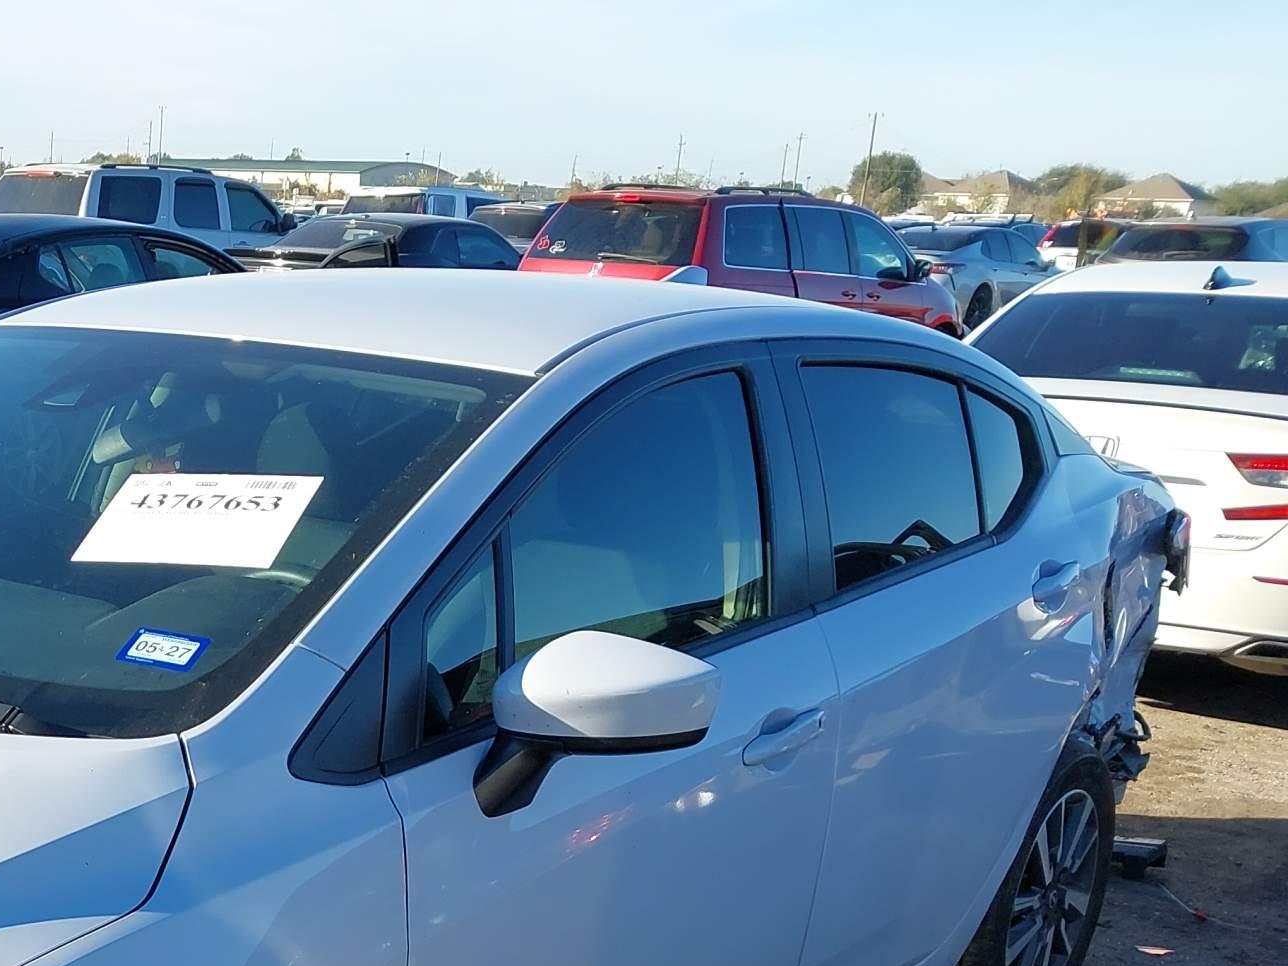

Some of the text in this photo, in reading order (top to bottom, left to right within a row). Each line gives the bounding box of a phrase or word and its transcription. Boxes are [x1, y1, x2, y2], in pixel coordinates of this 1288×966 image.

[130, 493, 283, 512] 43767653
[134, 640, 160, 654] 05
[164, 645, 193, 659] 27
